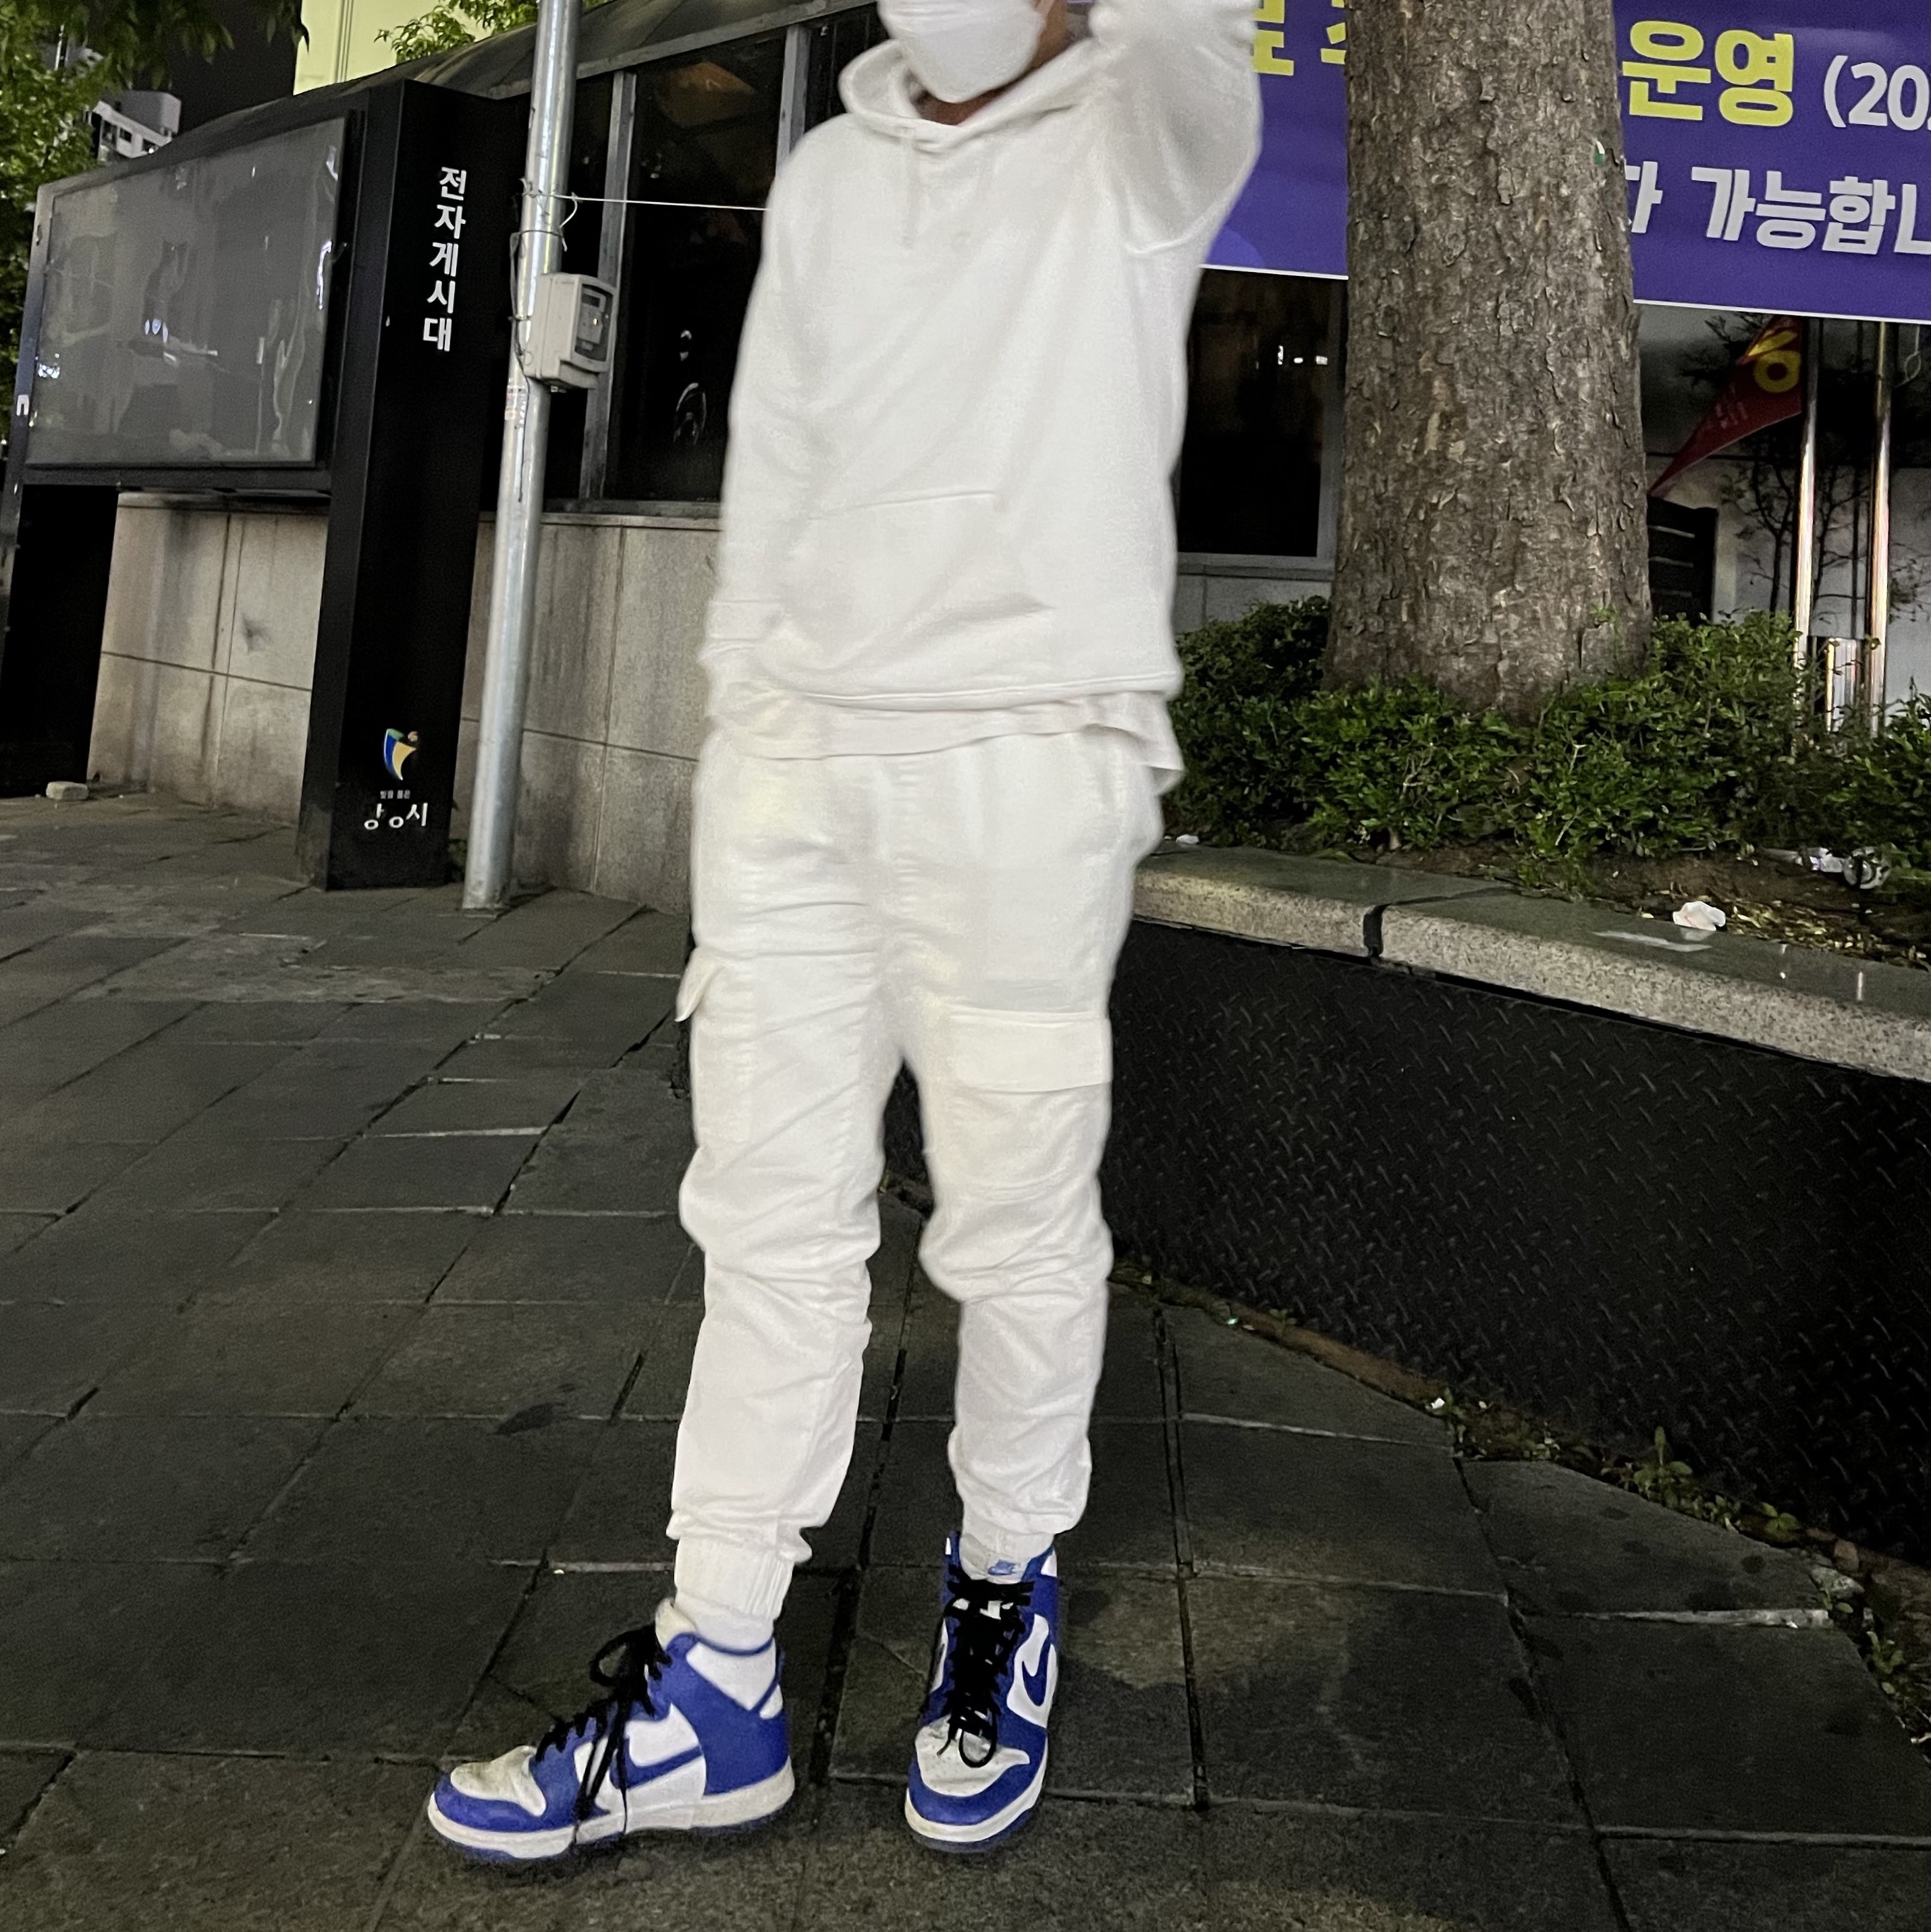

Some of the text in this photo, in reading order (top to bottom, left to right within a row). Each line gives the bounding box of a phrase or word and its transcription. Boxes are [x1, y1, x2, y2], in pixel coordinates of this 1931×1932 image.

[1623, 20, 1931, 131] 운영 (20
[423, 166, 467, 352] 전자게시대
